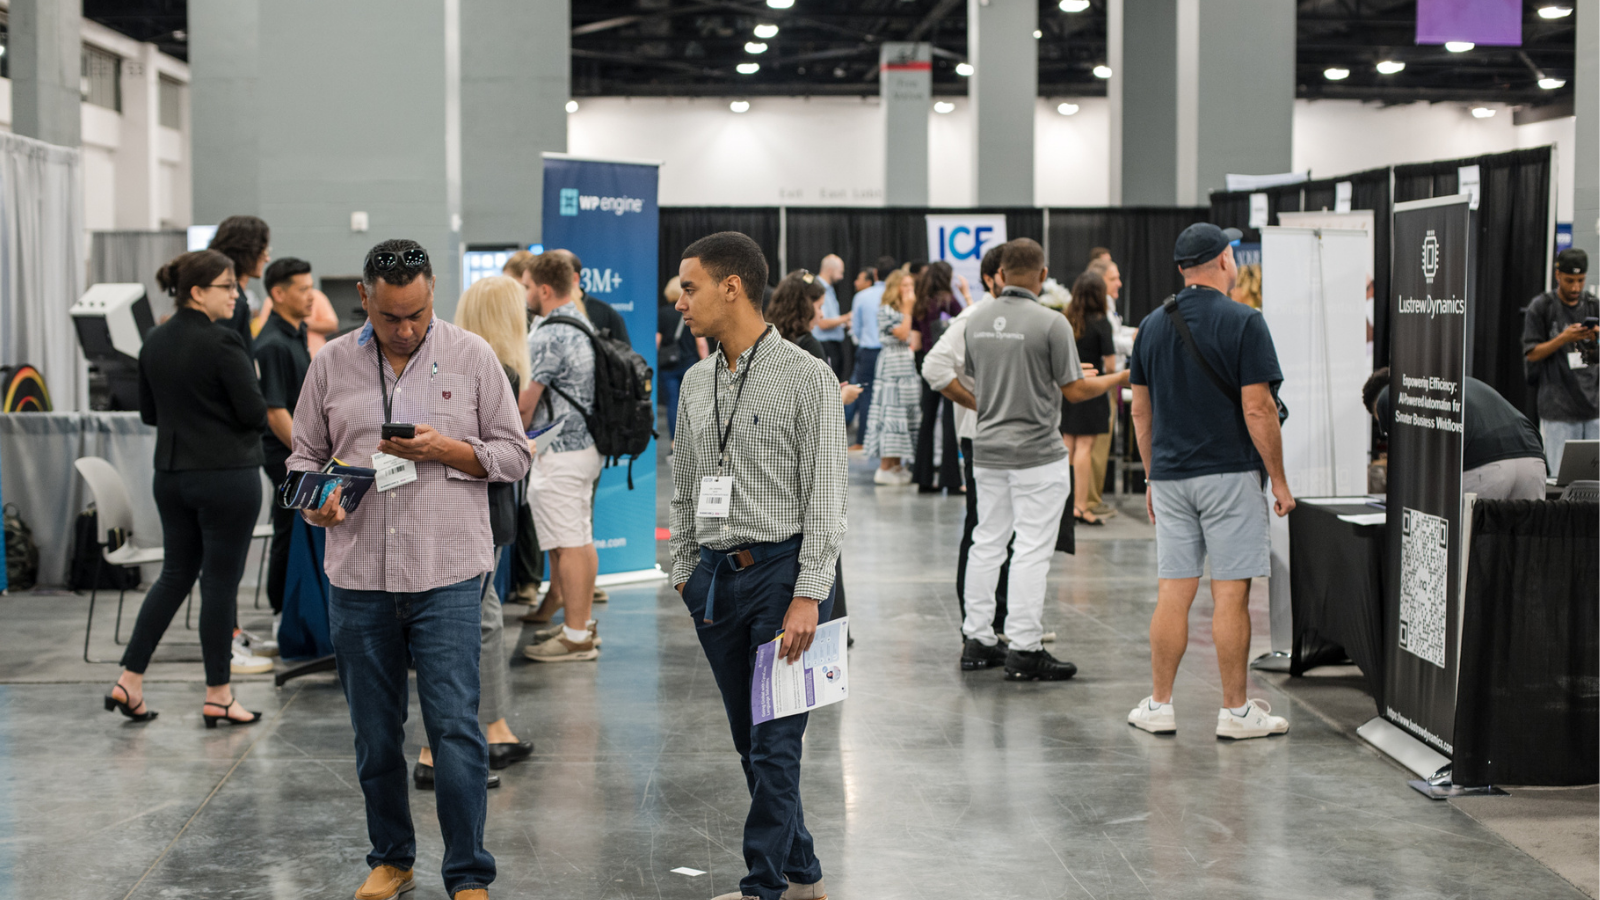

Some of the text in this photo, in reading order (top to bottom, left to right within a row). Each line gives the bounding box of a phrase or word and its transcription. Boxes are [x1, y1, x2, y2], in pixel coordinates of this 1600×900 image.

[579, 194, 643, 216] WP engine
[939, 226, 993, 260] ICF
[1398, 294, 1465, 320] Lustrew Dynamics
[995, 331, 1025, 340] Dynamics
[1452, 398, 1461, 413] for
[1413, 412, 1436, 429] Business
